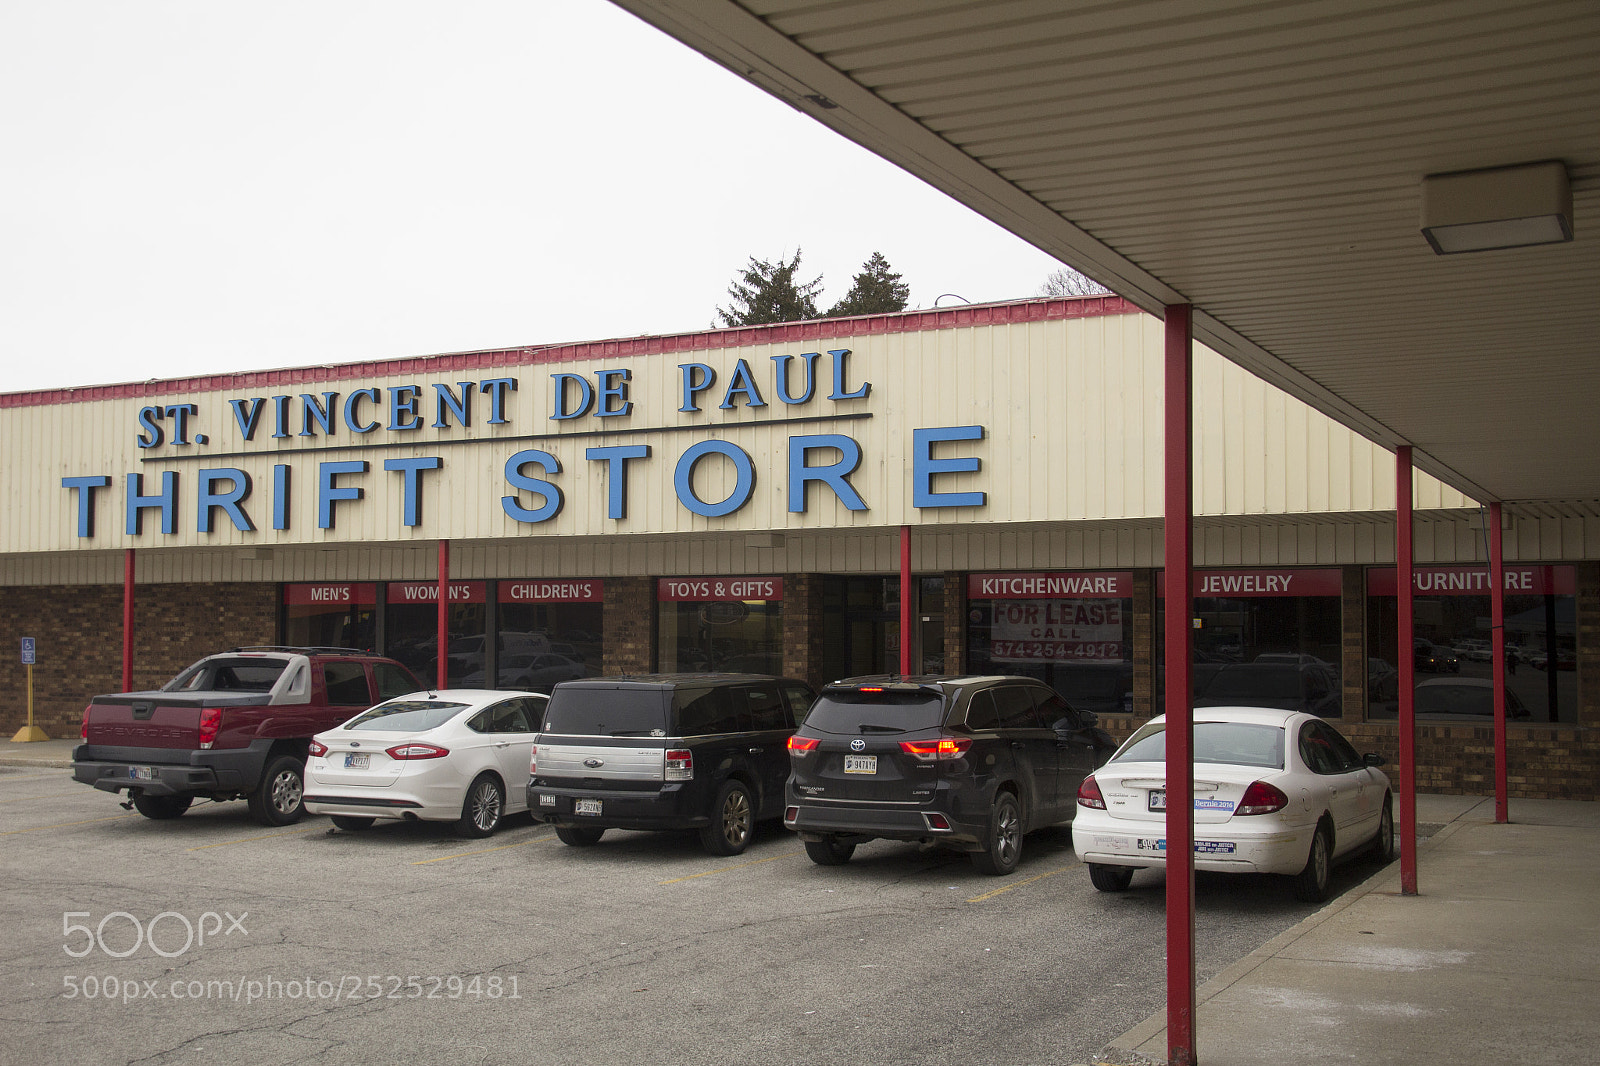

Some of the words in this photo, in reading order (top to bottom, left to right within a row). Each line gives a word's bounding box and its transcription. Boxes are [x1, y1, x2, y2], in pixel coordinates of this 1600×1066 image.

[137, 404, 209, 449] ST.
[228, 377, 519, 441] VINCENT
[549, 368, 633, 421] DE
[678, 349, 872, 413] PAUL
[61, 457, 444, 538] THRIFT
[501, 425, 988, 524] STORE
[668, 582, 710, 597] TOYS
[714, 582, 726, 597] &
[730, 581, 774, 597] GIFTS
[981, 577, 1118, 595] KITCHENWARE
[1200, 575, 1293, 593] JEWELRY
[1412, 571, 1533, 591] URNITRE
[310, 587, 350, 601] MEN'S
[403, 585, 471, 600] WOMN'S
[510, 584, 593, 600] CHILDREN'S
[994, 602, 1039, 625] FOR
[1045, 603, 1120, 625] LEASE
[1030, 628, 1081, 639] CALL
[994, 643, 1119, 657] 574-254-4912
[1195, 799, 1218, 807] Bernie
[1218, 801, 1233, 809] 2016
